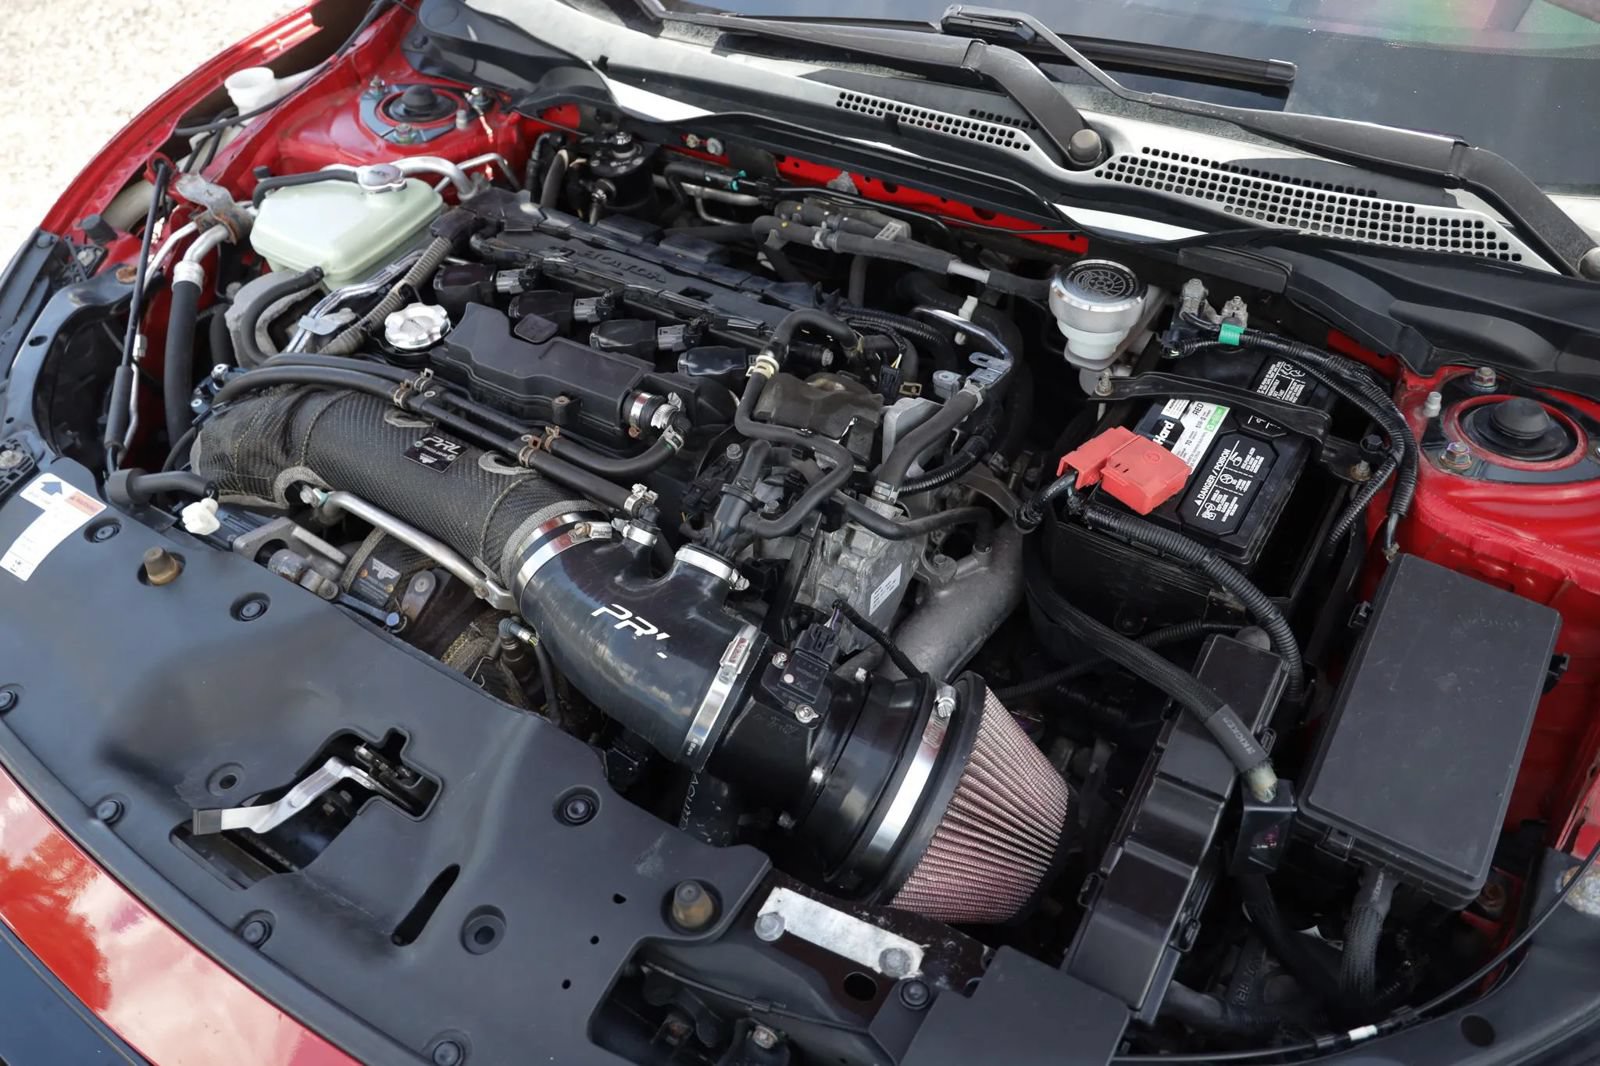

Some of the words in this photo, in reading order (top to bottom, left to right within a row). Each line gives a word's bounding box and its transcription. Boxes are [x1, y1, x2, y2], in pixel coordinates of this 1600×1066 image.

[422, 435, 461, 455] PRL
[1153, 420, 1175, 445] Hard
[1197, 474, 1216, 500] DANGER
[1213, 448, 1231, 471] POISON
